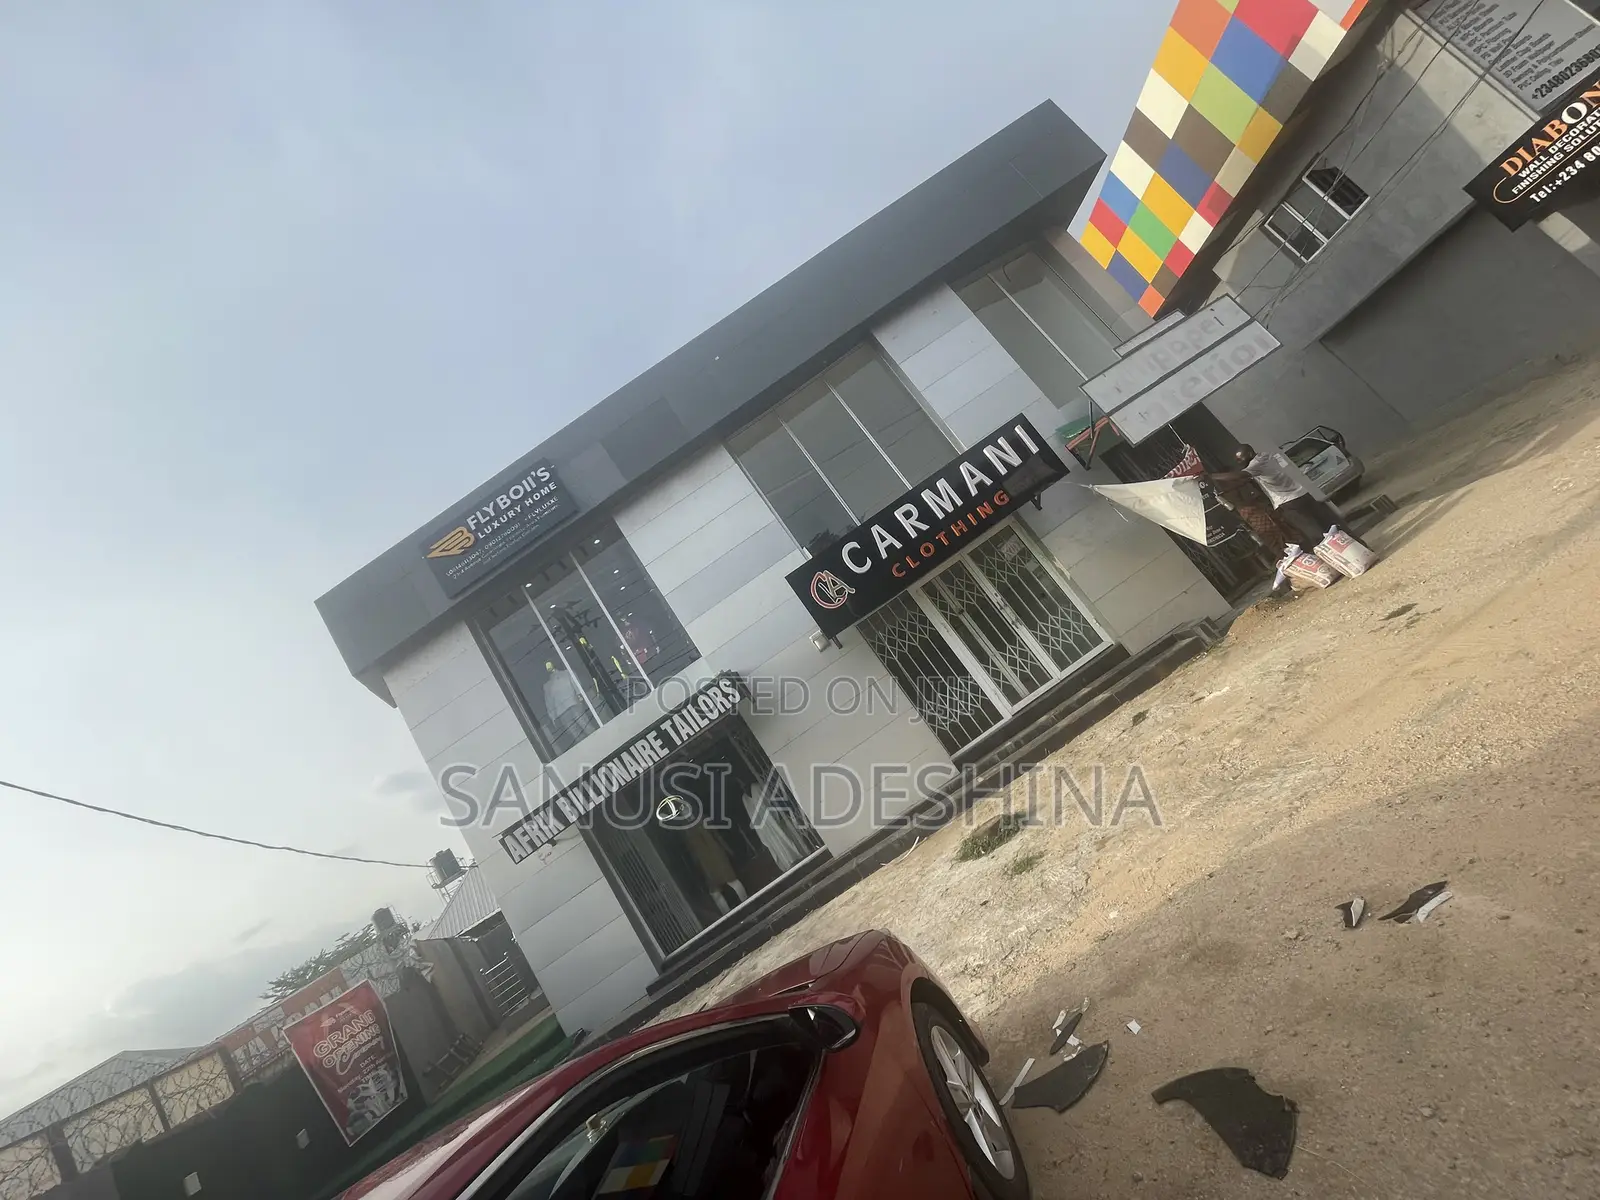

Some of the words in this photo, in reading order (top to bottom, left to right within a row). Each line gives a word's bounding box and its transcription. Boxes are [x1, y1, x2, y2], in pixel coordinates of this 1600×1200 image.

[1512, 152, 1565, 195] FINISHING
[1518, 155, 1549, 178] WALL
[477, 504, 523, 539] LUXURY
[524, 481, 557, 507] HOME
[841, 424, 1040, 574] CARMANI
[890, 489, 1010, 579] CLOTHING
[555, 731, 670, 824] BILLIONAIRE
[659, 678, 741, 746] TAILORS
[313, 1009, 376, 1058] GRAND
[322, 1023, 381, 1069] OPENING
